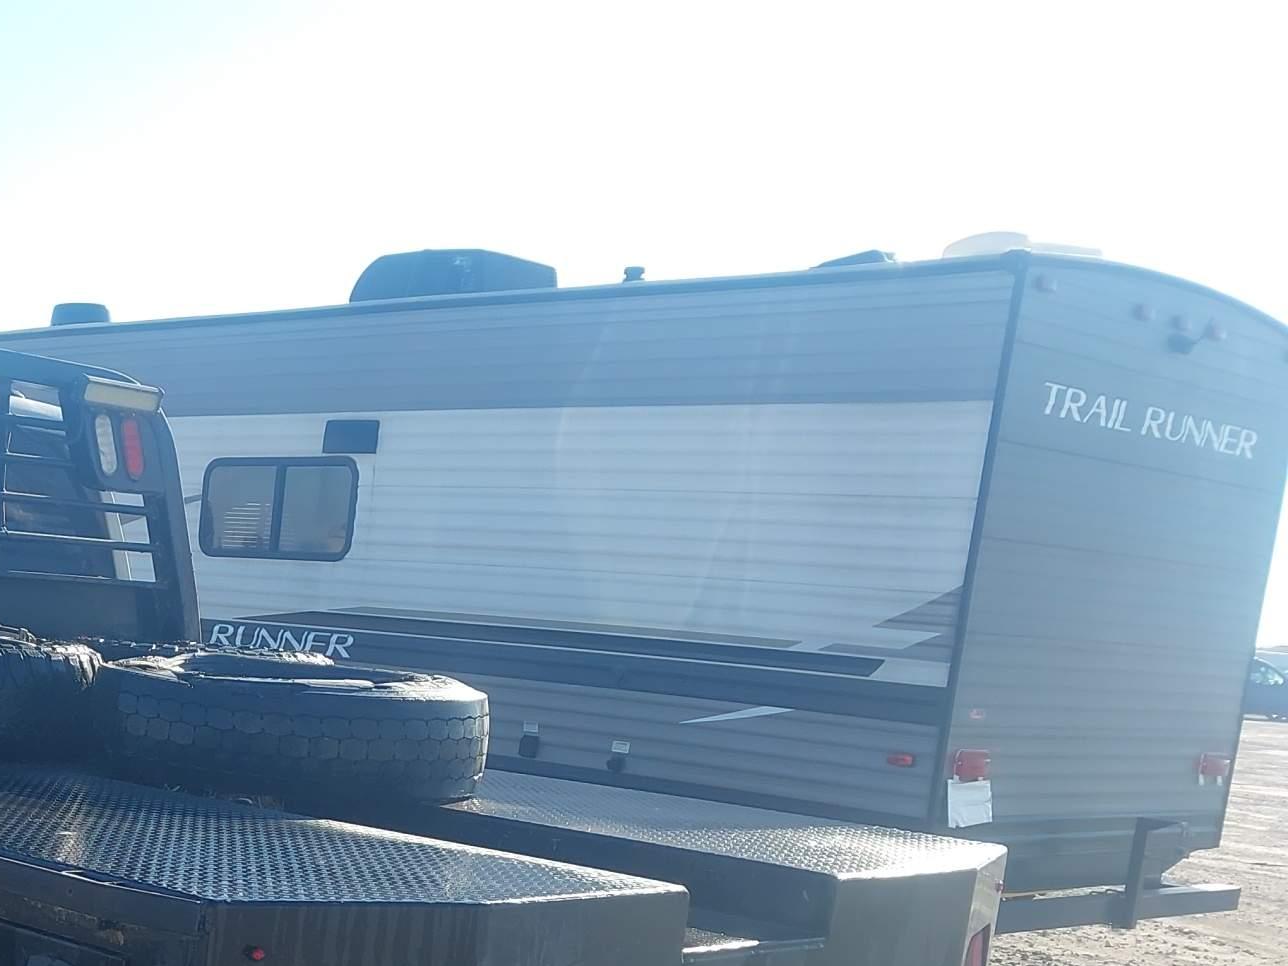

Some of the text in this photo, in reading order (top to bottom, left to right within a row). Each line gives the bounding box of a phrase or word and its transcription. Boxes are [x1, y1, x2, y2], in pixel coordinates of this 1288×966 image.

[1043, 381, 1259, 459] TRAIL RUNNER
[209, 623, 355, 659] RUNNER
